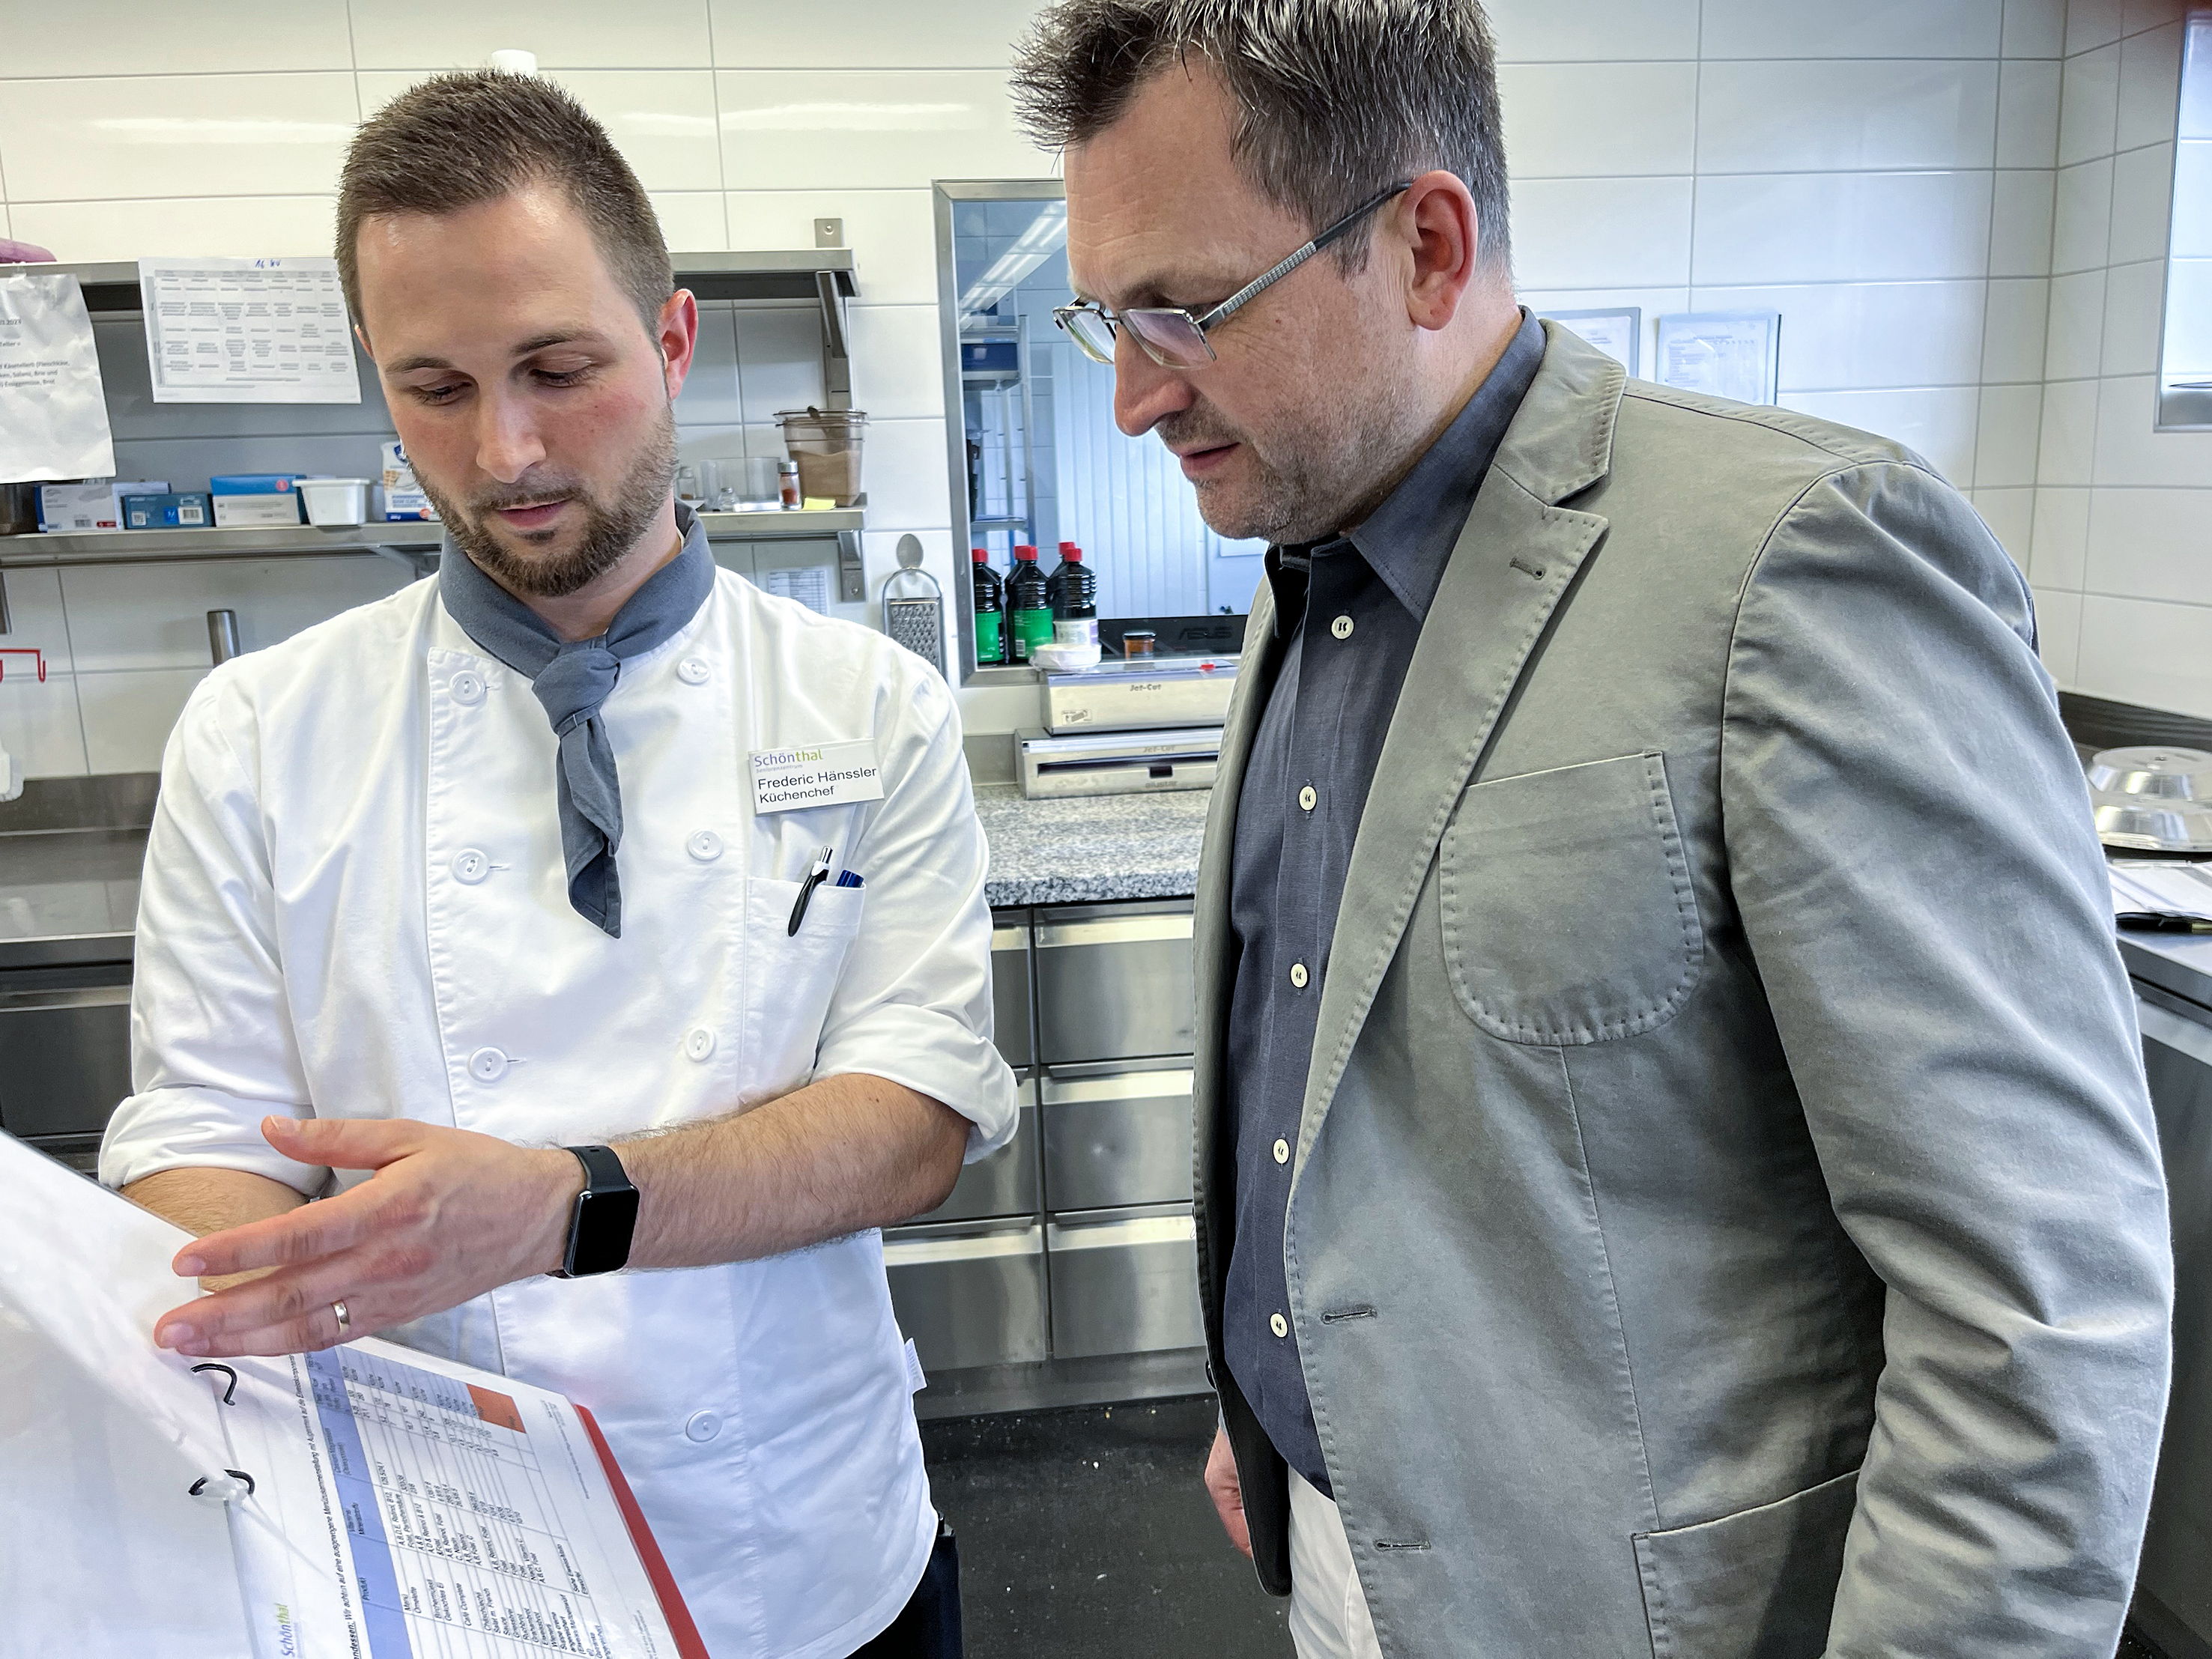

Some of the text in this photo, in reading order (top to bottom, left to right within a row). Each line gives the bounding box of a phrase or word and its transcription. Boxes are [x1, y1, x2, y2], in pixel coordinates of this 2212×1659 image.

[754, 749, 824, 768] Schönthal
[756, 764, 804, 774] Seniorenzentrum
[758, 767, 877, 790] Frederic Hänssler
[760, 785, 835, 804] Küchenchef
[309, 1443, 317, 1451] mit
[327, 1516, 341, 1557] ausgewogene
[335, 1558, 344, 1572] eine
[336, 1572, 346, 1584] auf
[570, 1577, 580, 1592] Siehe
[340, 1585, 351, 1607] achten
[357, 1577, 369, 1601] Produkt
[455, 1583, 467, 1610] Complete
[483, 1588, 494, 1607] French
[402, 1594, 410, 1610] Menü
[410, 1586, 421, 1613] Omelette
[440, 1589, 452, 1621] Gekochtes
[343, 1608, 352, 1620] Wir
[462, 1611, 471, 1626] Café
[507, 1608, 520, 1637] Griessbrei
[551, 1611, 560, 1629] creme
[273, 1603, 294, 1657] Schönthal
[491, 1617, 500, 1634] Salat
[500, 1616, 511, 1635] Sauce
[517, 1613, 531, 1640] Ruchbrot
[524, 1607, 539, 1643] Grahambrot
[533, 1611, 548, 1645] Eiweissbrot
[560, 1616, 576, 1652] angereichert
[546, 1624, 557, 1647] Wienerli
[557, 1631, 567, 1650] Suppe
